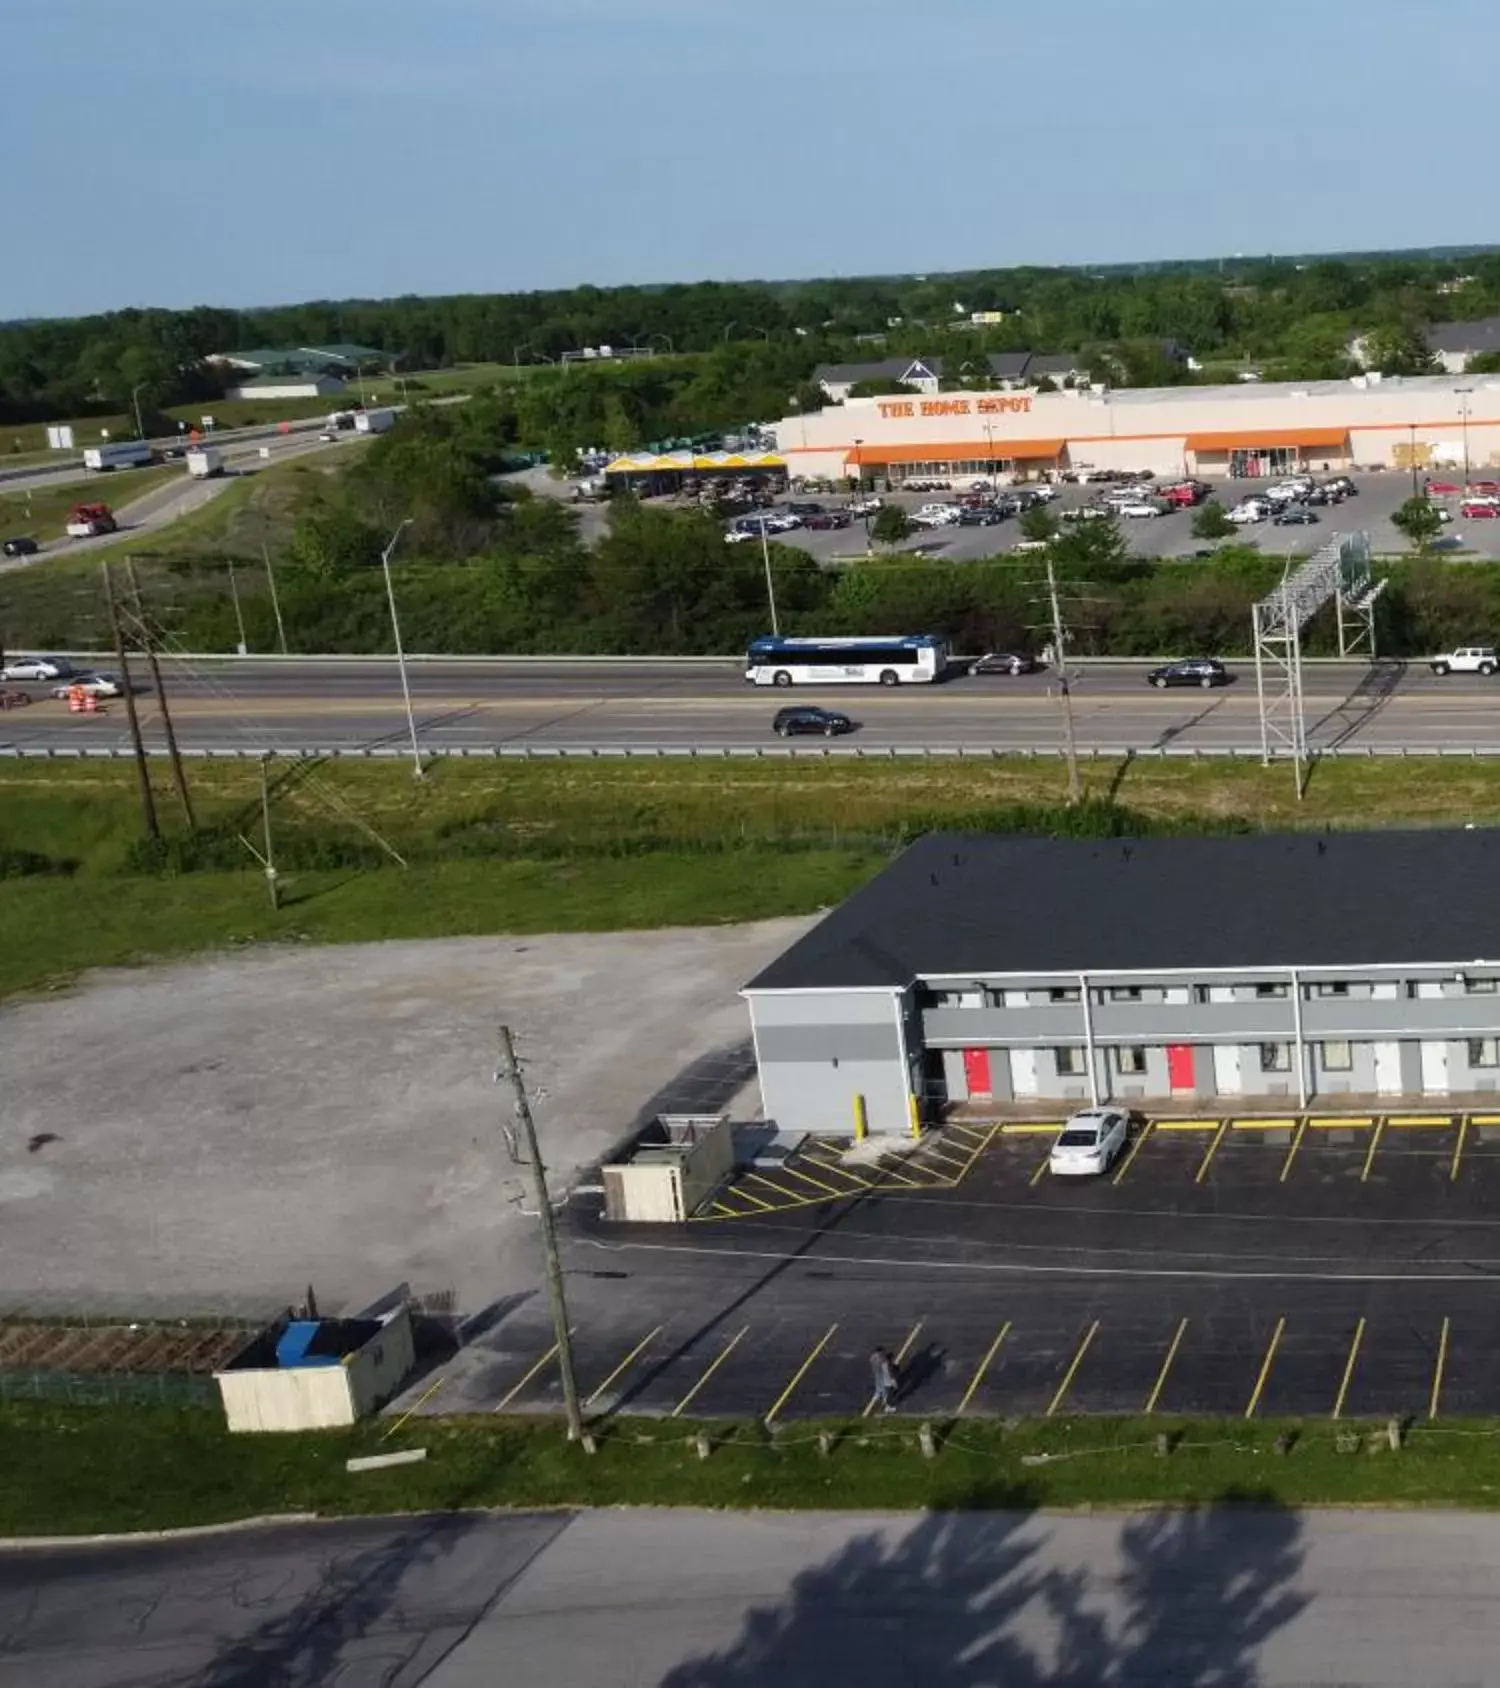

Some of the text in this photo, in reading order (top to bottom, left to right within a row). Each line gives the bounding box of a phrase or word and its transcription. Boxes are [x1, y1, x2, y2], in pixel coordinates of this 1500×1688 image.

[877, 397, 1033, 418] THE HOME DEPOT
